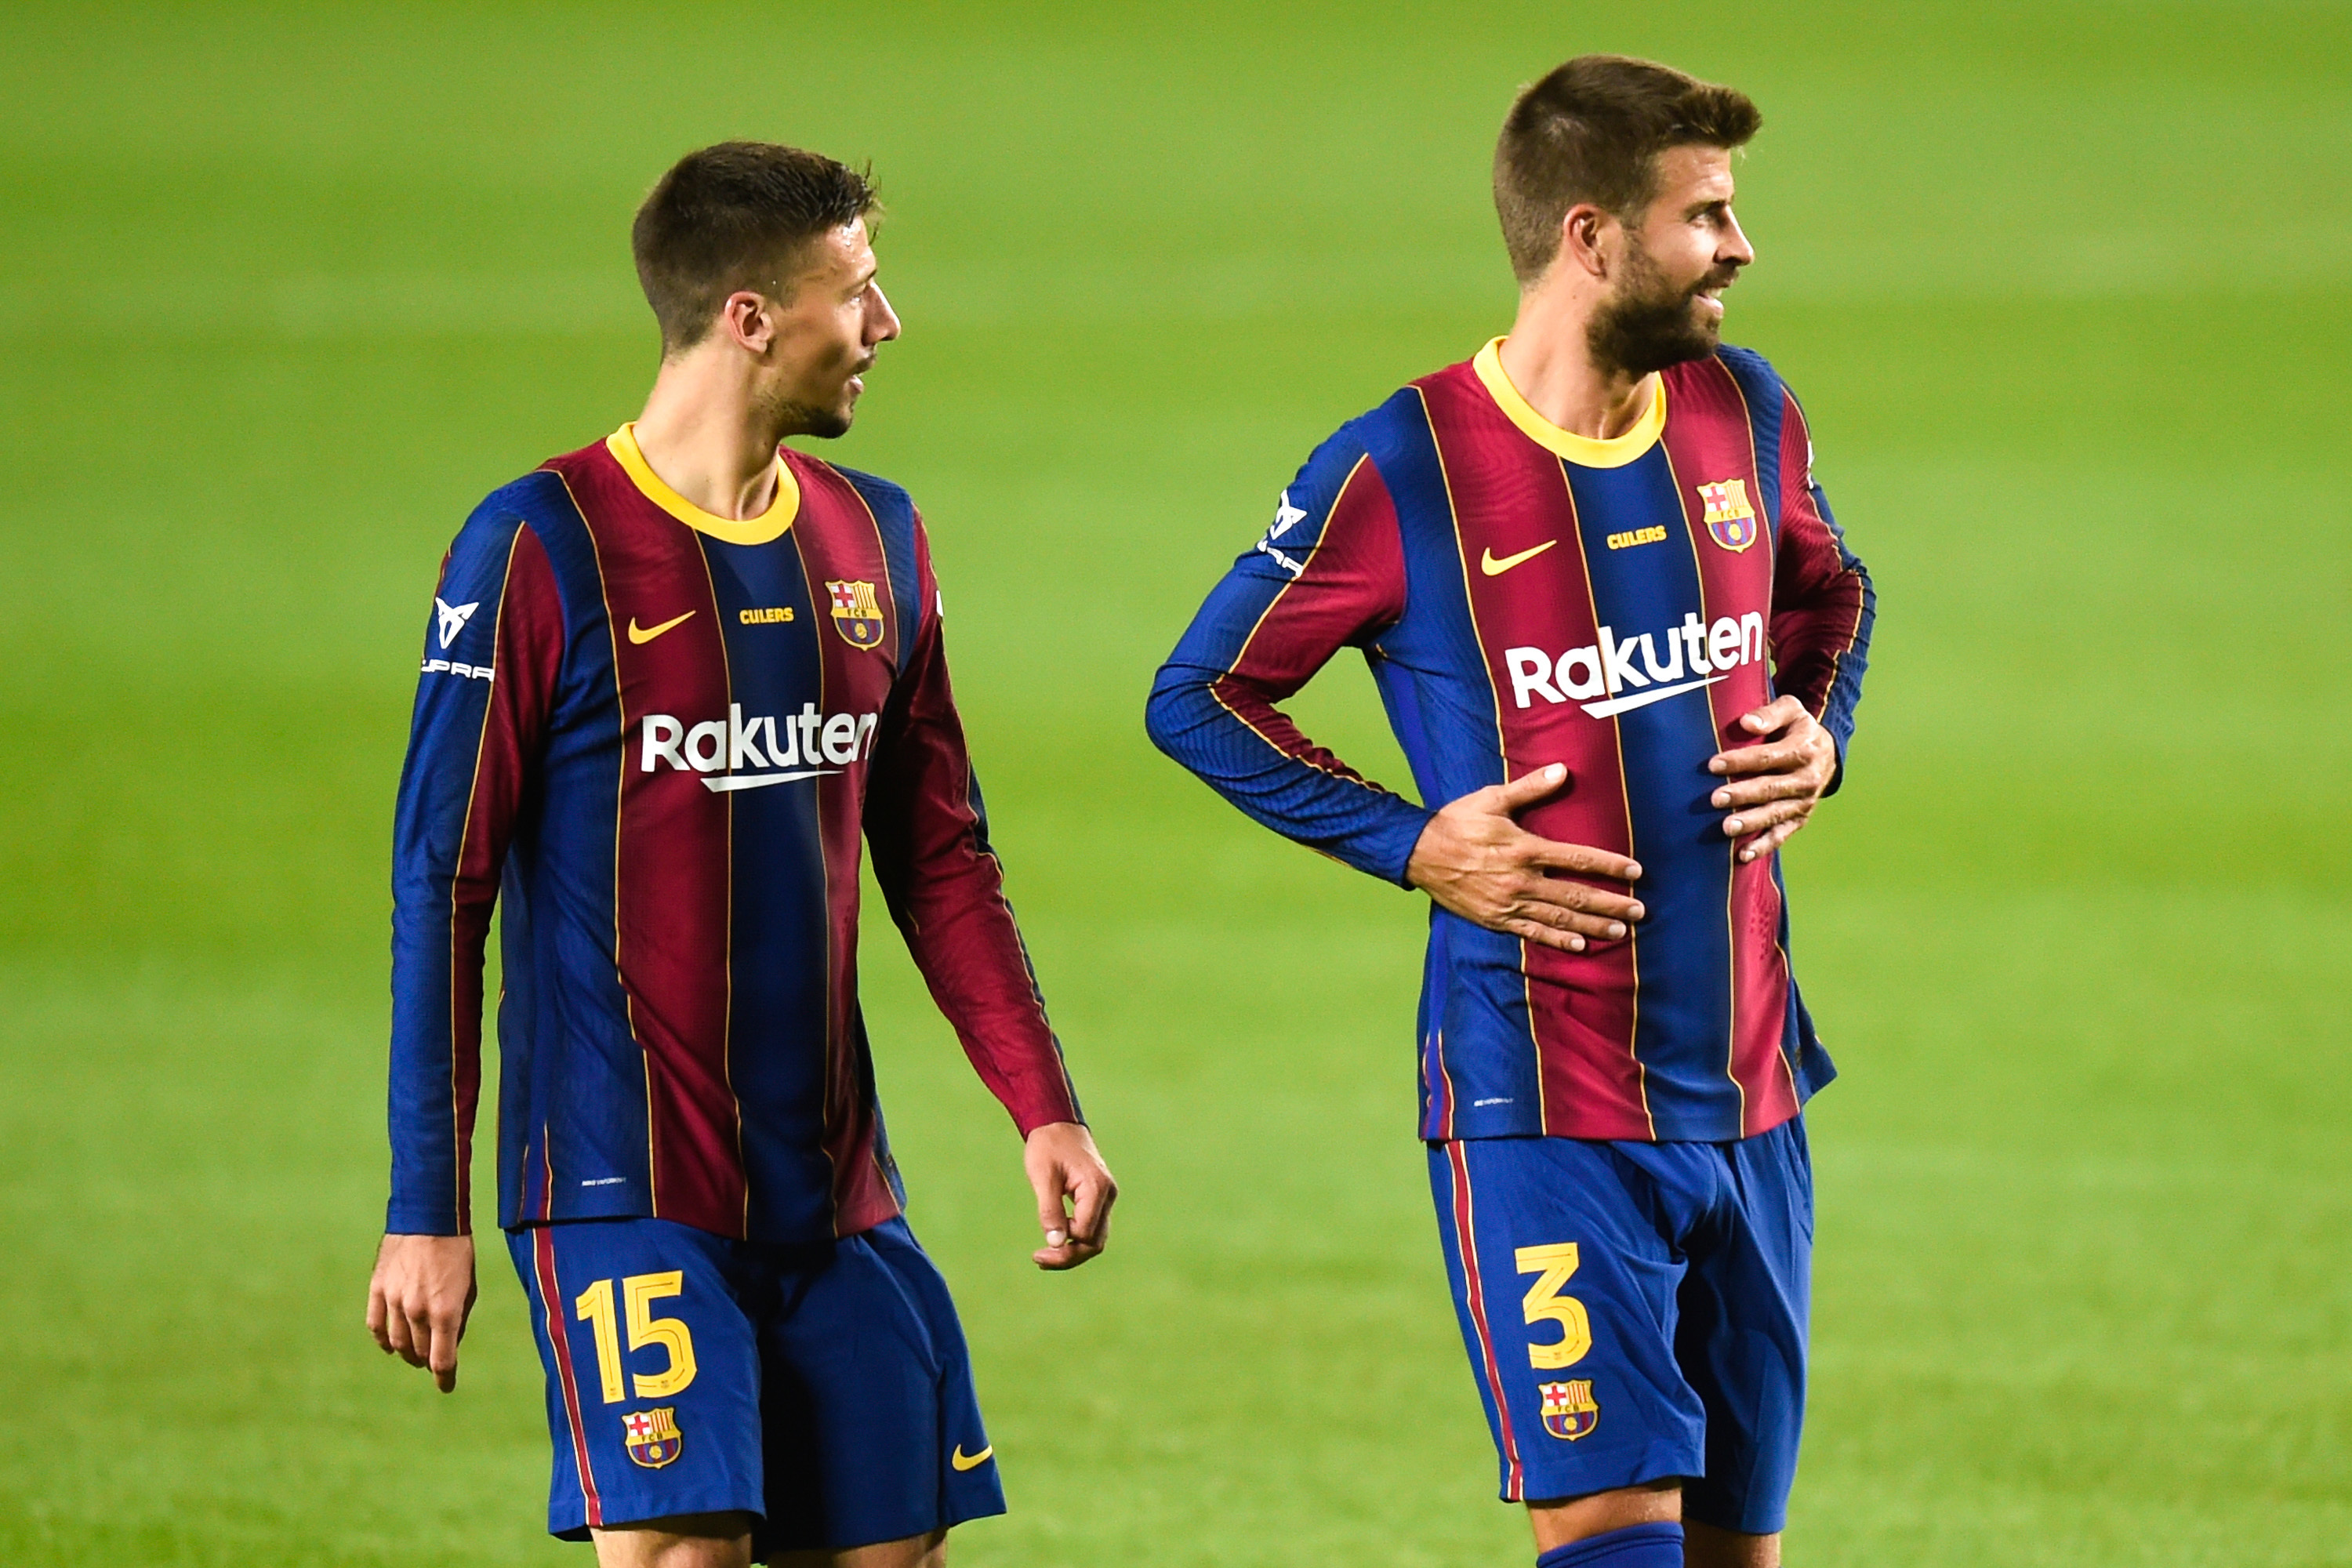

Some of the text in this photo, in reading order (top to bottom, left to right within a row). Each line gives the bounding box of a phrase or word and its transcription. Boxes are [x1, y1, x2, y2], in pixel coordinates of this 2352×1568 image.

[1607, 524, 1668, 550] CULERS
[739, 606, 794, 625] CULERS
[421, 659, 495, 682] UPRA
[1504, 611, 1763, 709] Rakuten
[641, 702, 877, 773] Rakuten
[575, 1270, 697, 1403] 15
[1514, 1242, 1592, 1370] 3
